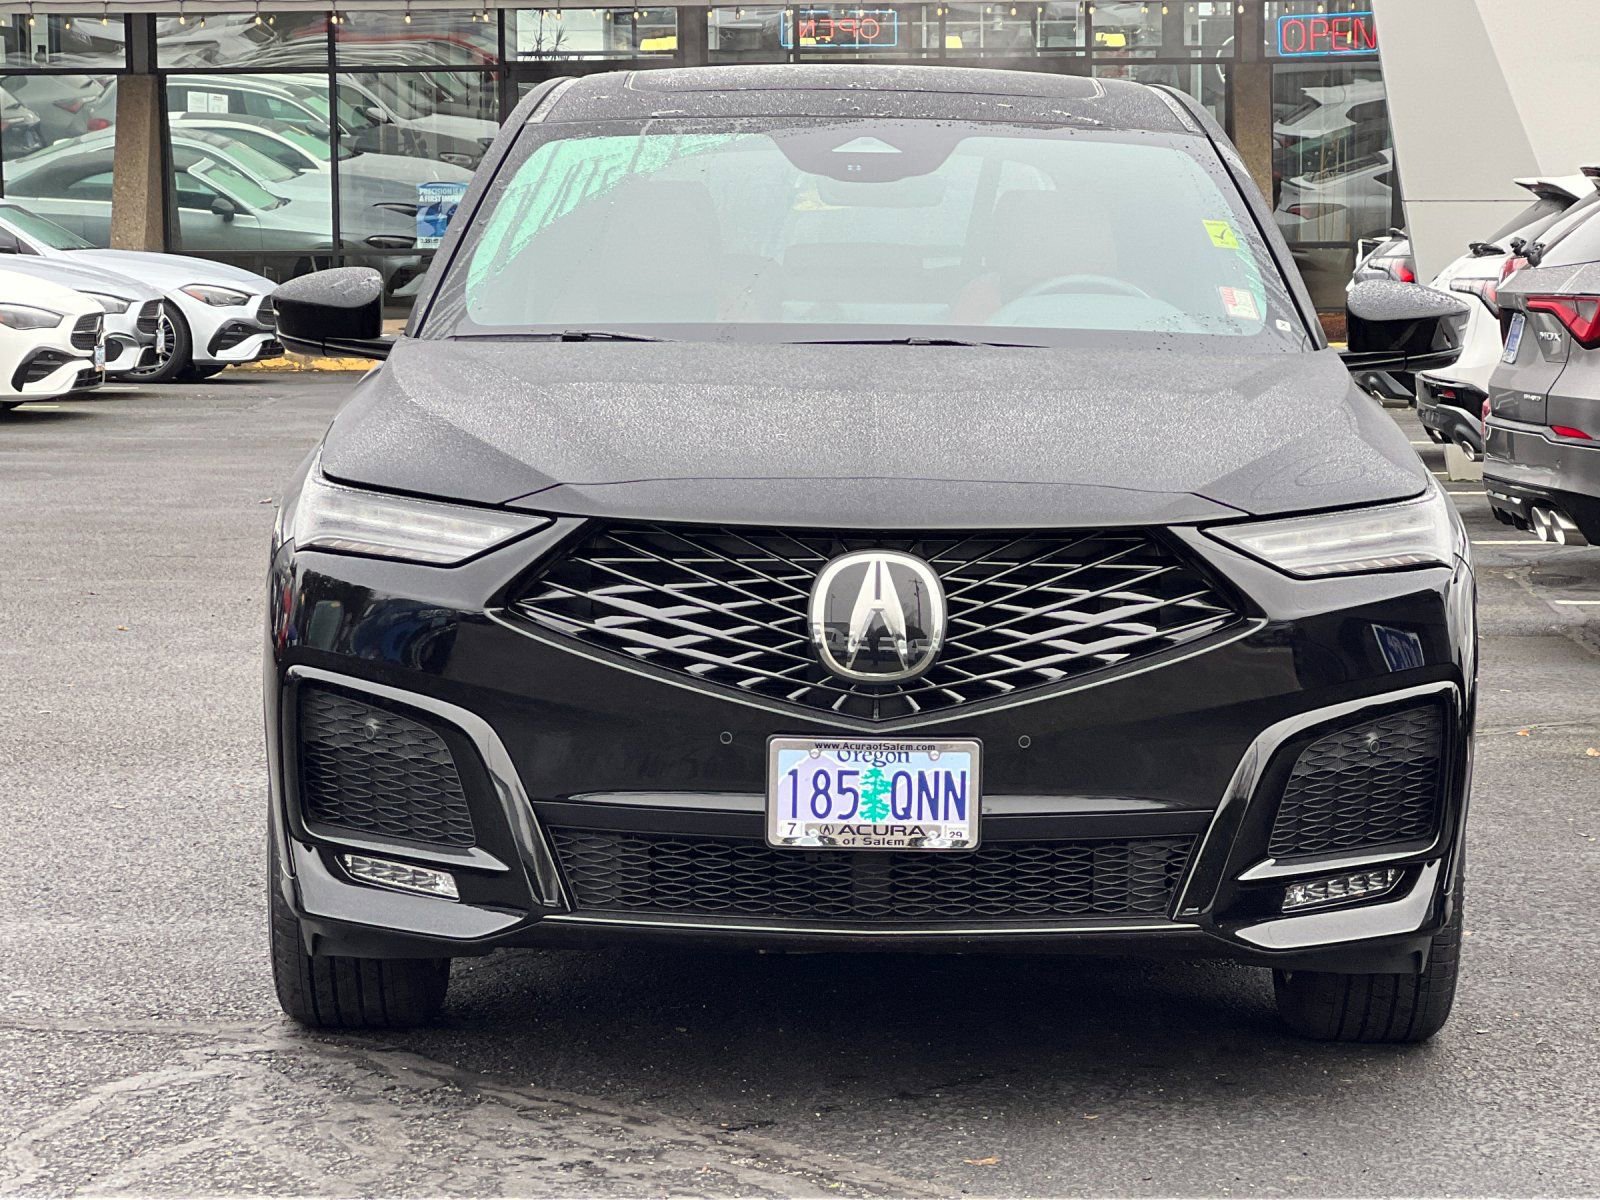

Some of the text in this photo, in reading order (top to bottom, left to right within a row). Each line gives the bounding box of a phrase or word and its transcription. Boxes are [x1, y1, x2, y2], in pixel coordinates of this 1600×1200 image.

[1282, 18, 1377, 52] OPEN
[1539, 331, 1561, 342] MDX
[814, 742, 936, 751] www.AcuraofSalem.com
[837, 750, 912, 767] Oregon
[787, 768, 967, 821] 185 QNN
[787, 822, 797, 836] 7
[837, 824, 927, 837] ACURA
[842, 837, 905, 846] of Salem
